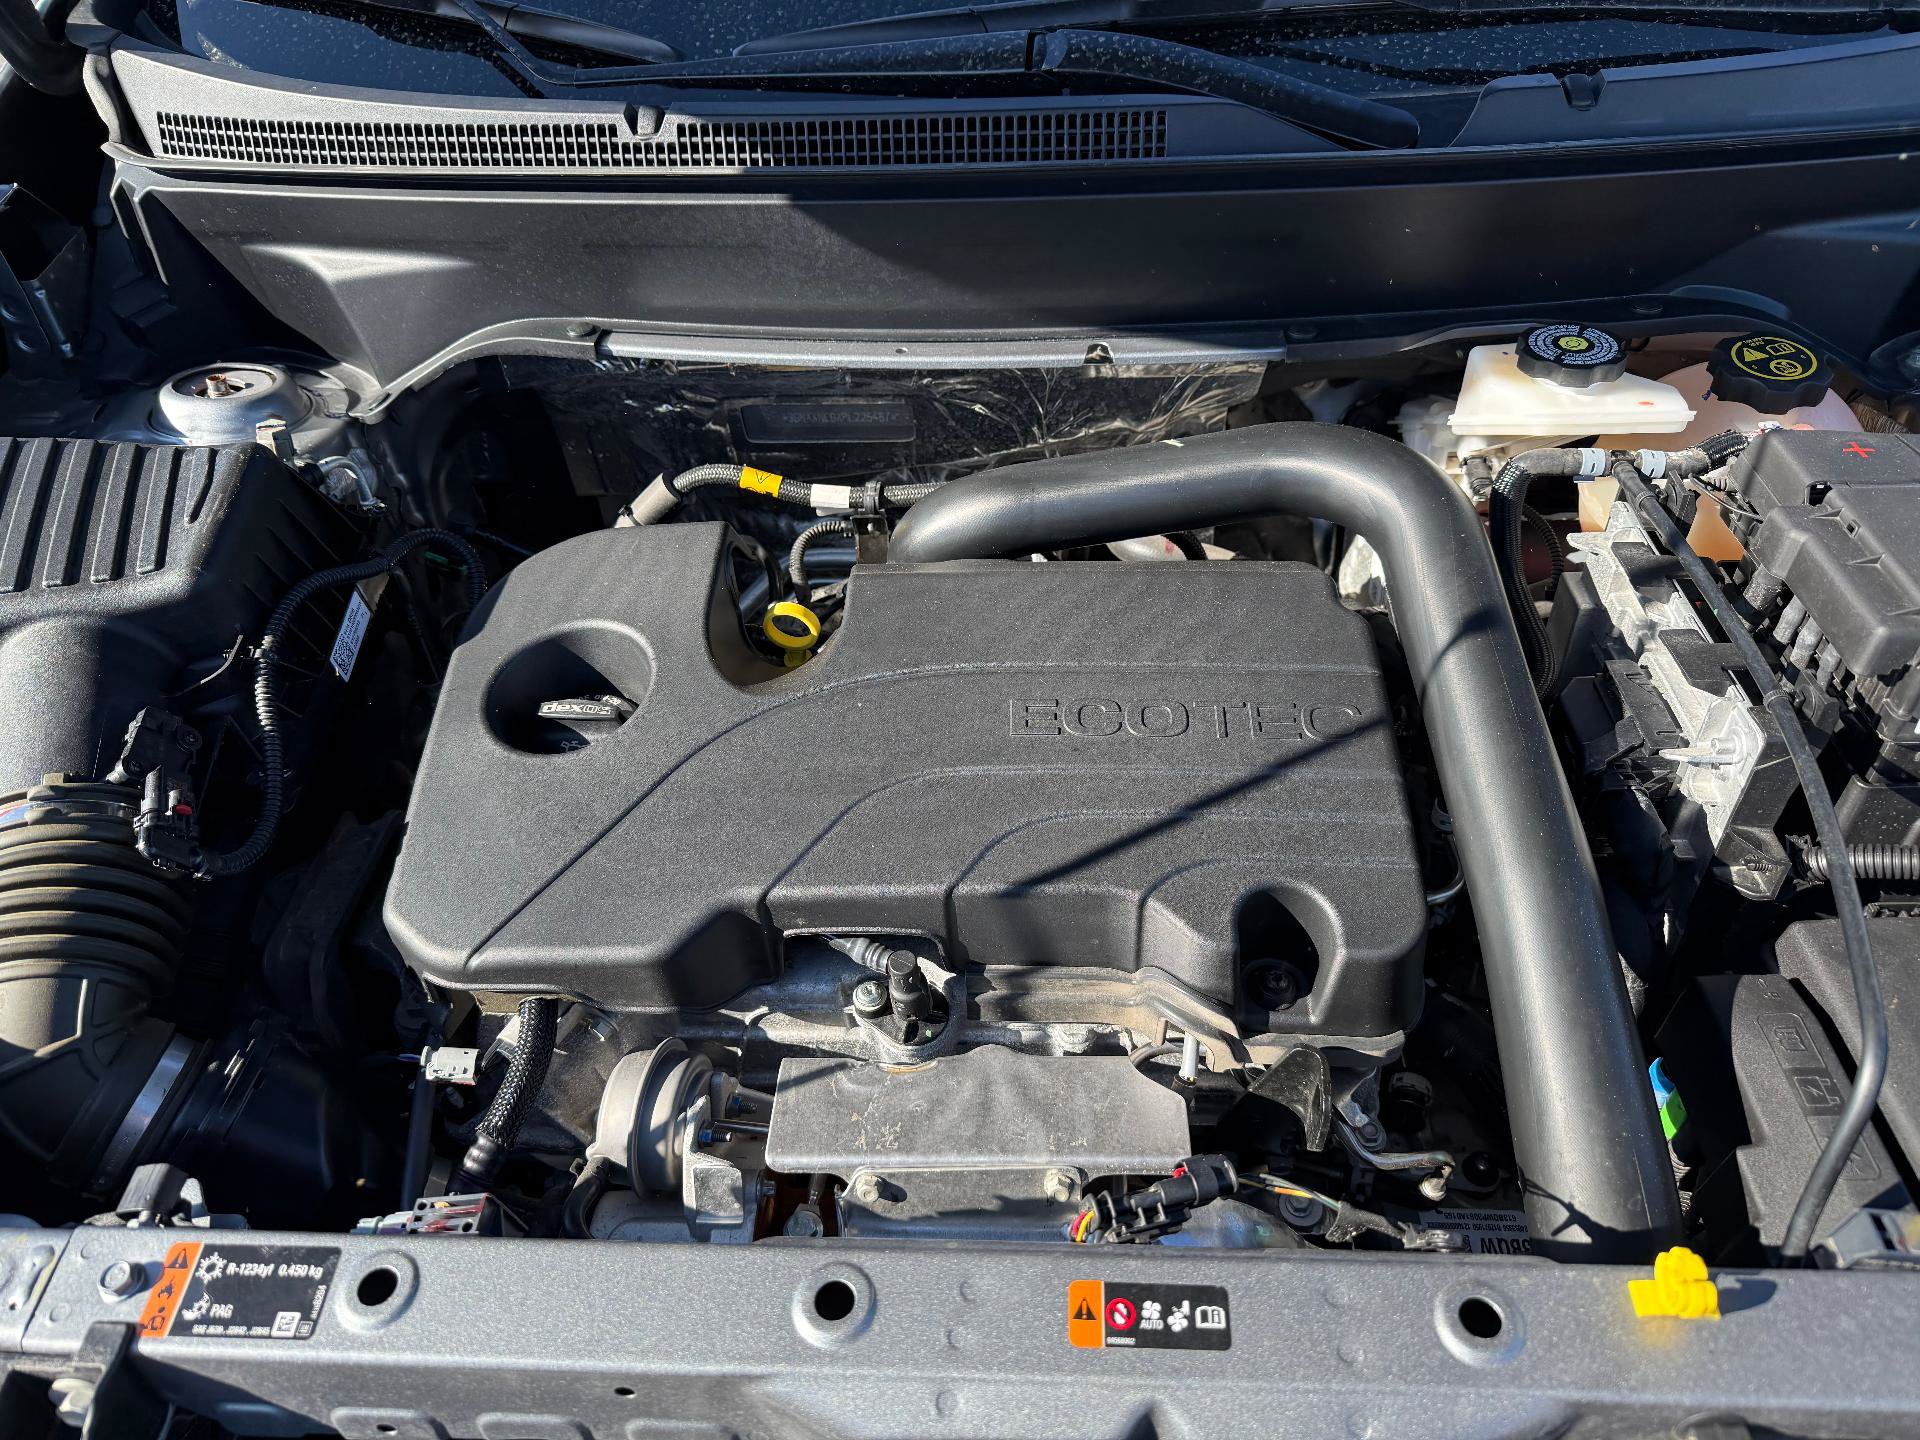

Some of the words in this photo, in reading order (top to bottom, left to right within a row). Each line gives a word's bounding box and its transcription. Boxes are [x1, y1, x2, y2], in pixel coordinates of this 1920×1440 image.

[542, 703, 612, 715] dexos
[1010, 699, 1365, 742] ECOTEC
[278, 1263, 308, 1278] 0.450
[308, 1265, 324, 1280] kg
[209, 1303, 234, 1319] PAG
[1139, 1319, 1165, 1330] AUTO
